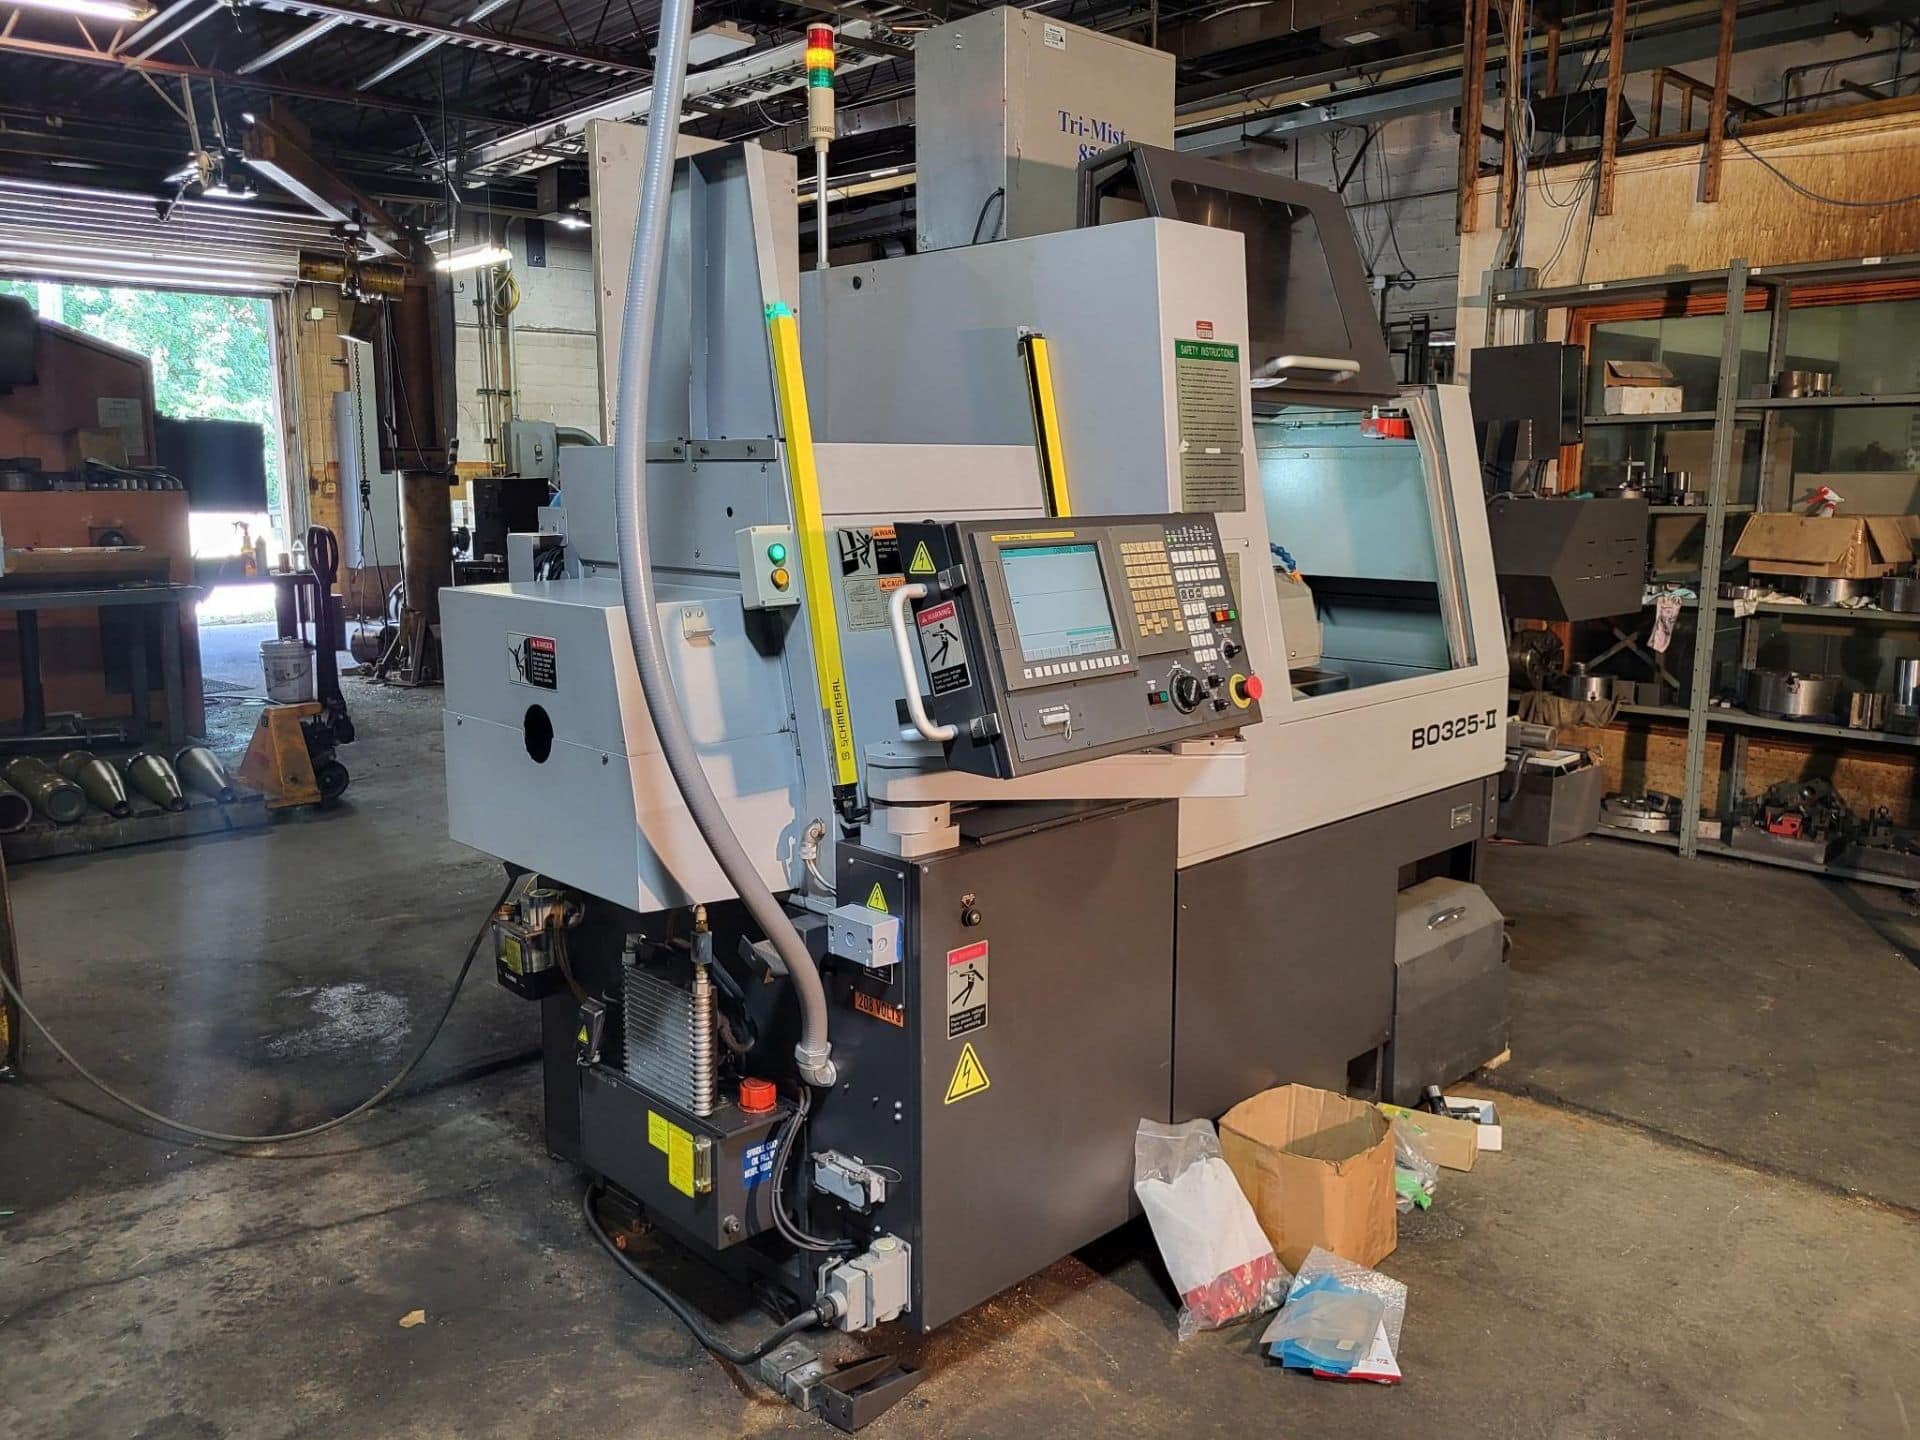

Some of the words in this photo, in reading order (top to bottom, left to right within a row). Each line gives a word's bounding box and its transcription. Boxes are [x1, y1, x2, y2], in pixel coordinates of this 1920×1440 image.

[1058, 109, 1127, 145] Tri-Mist
[1180, 344, 1199, 356] SAFETY
[1200, 346, 1235, 359] INSTRUCTIONS
[832, 678, 849, 748] SCHMERSAL
[858, 994, 874, 1013] 208
[876, 999, 902, 1023] VOLTS
